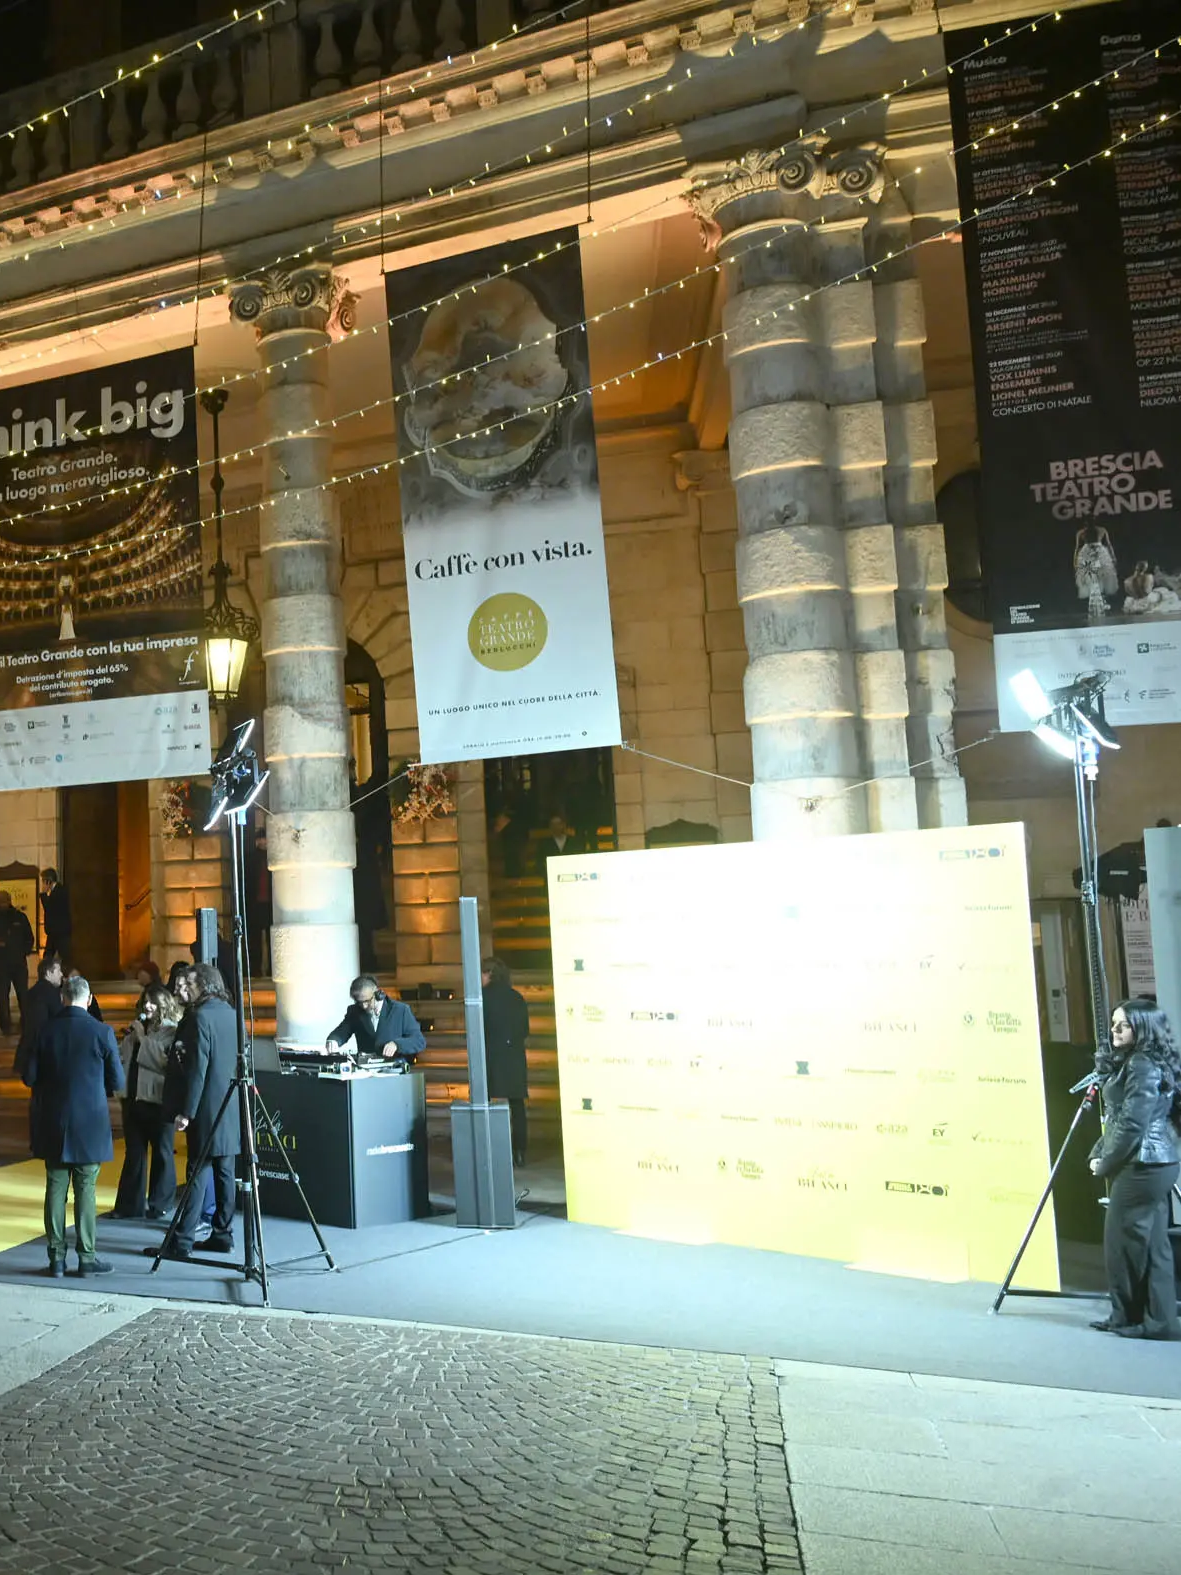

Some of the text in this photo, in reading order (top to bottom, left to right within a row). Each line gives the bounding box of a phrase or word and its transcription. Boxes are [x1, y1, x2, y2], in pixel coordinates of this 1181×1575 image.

[989, 365, 1058, 382] VOX LUMINIS
[990, 376, 1041, 391] ENSEMBLE
[991, 382, 1074, 402] LIONEL MEUNIER
[1140, 398, 1177, 408] NUOVA
[100, 381, 185, 440] big
[992, 395, 1093, 417] CONCERTO DI NATALE
[11, 451, 119, 482] Teatro Grande.
[1049, 450, 1164, 481] BRESCIA
[5, 481, 47, 504] luogo
[50, 465, 150, 494] meraviglioso.
[1029, 473, 1136, 503] TEATRO
[1051, 490, 1174, 521] GRANDE
[415, 541, 593, 581] Caffè con vista.
[480, 619, 536, 635] TEATRO
[480, 631, 536, 646] GRANDE
[0, 657, 6, 667] il
[7, 653, 40, 667] Teatro
[41, 647, 84, 663] Grande
[86, 646, 108, 656] con
[110, 642, 122, 654] la
[123, 640, 144, 652] tua
[146, 636, 199, 652] impresa
[16, 672, 56, 685] Detrazione
[96, 665, 109, 675] del
[109, 663, 129, 673] 65%
[29, 677, 115, 692] del contributo erogato.
[443, 705, 471, 714] LUOGO
[473, 702, 499, 711] UNICO
[502, 700, 516, 708] NEL
[519, 697, 546, 705] CUORE
[548, 693, 573, 702] DELLA
[932, 1128, 945, 1137] EY
